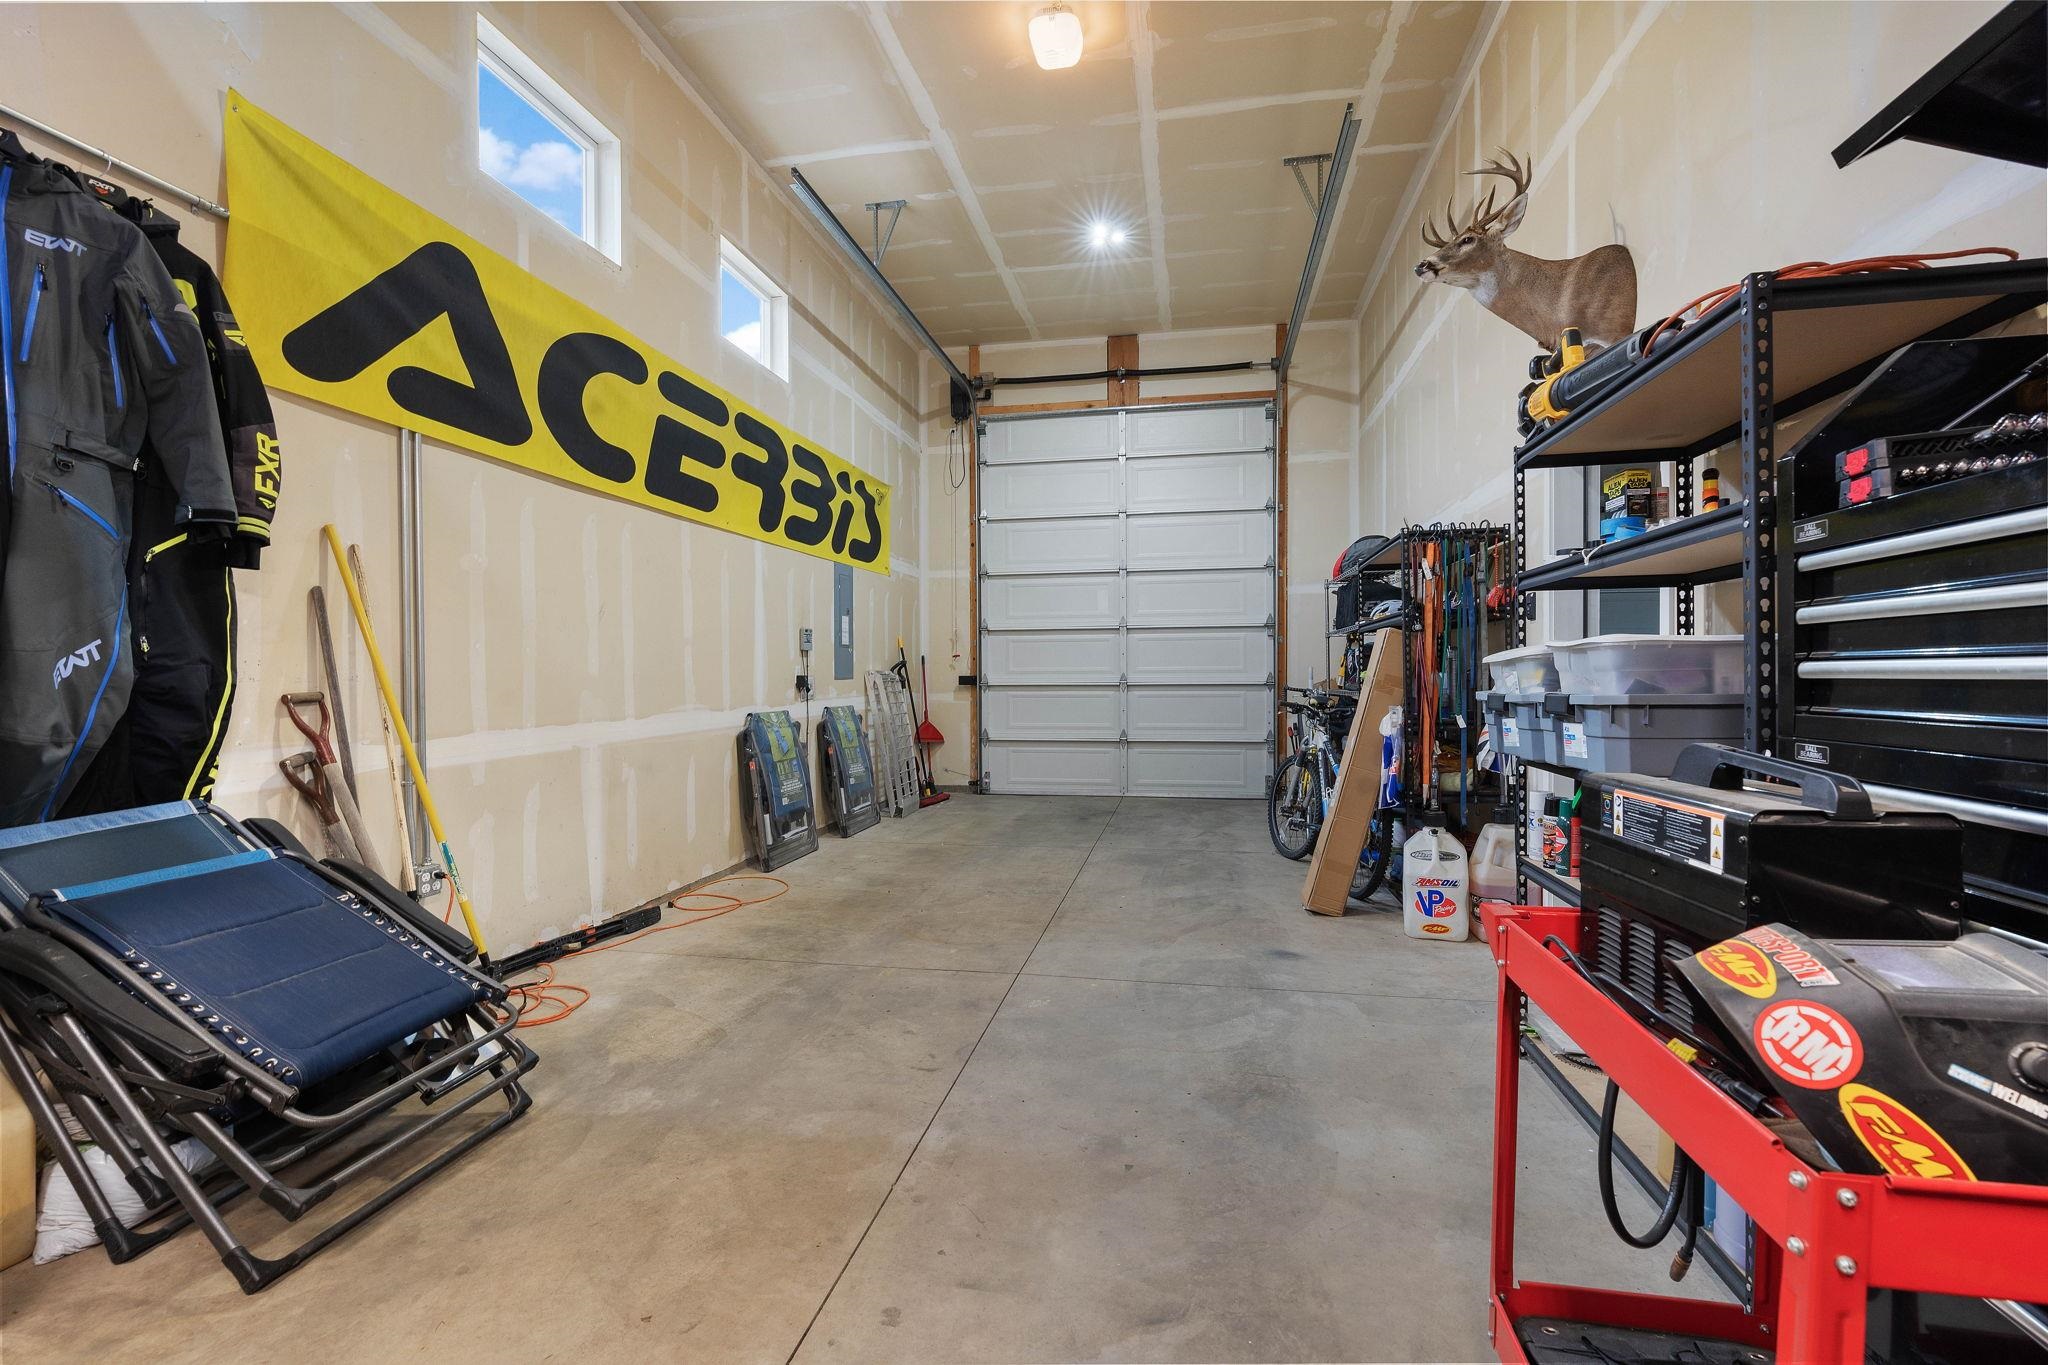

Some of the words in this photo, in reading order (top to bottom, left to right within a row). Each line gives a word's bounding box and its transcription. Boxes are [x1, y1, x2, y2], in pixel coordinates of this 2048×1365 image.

[281, 241, 883, 564] ACERBIS
[254, 431, 281, 497] FXR
[1415, 877, 1460, 888] AMSOIL
[1416, 889, 1445, 918] VP
[1435, 904, 1457, 914] Racing
[1709, 944, 1770, 985] FMF
[1764, 1005, 1854, 1081] RM
[1847, 1101, 1955, 1180] FM
